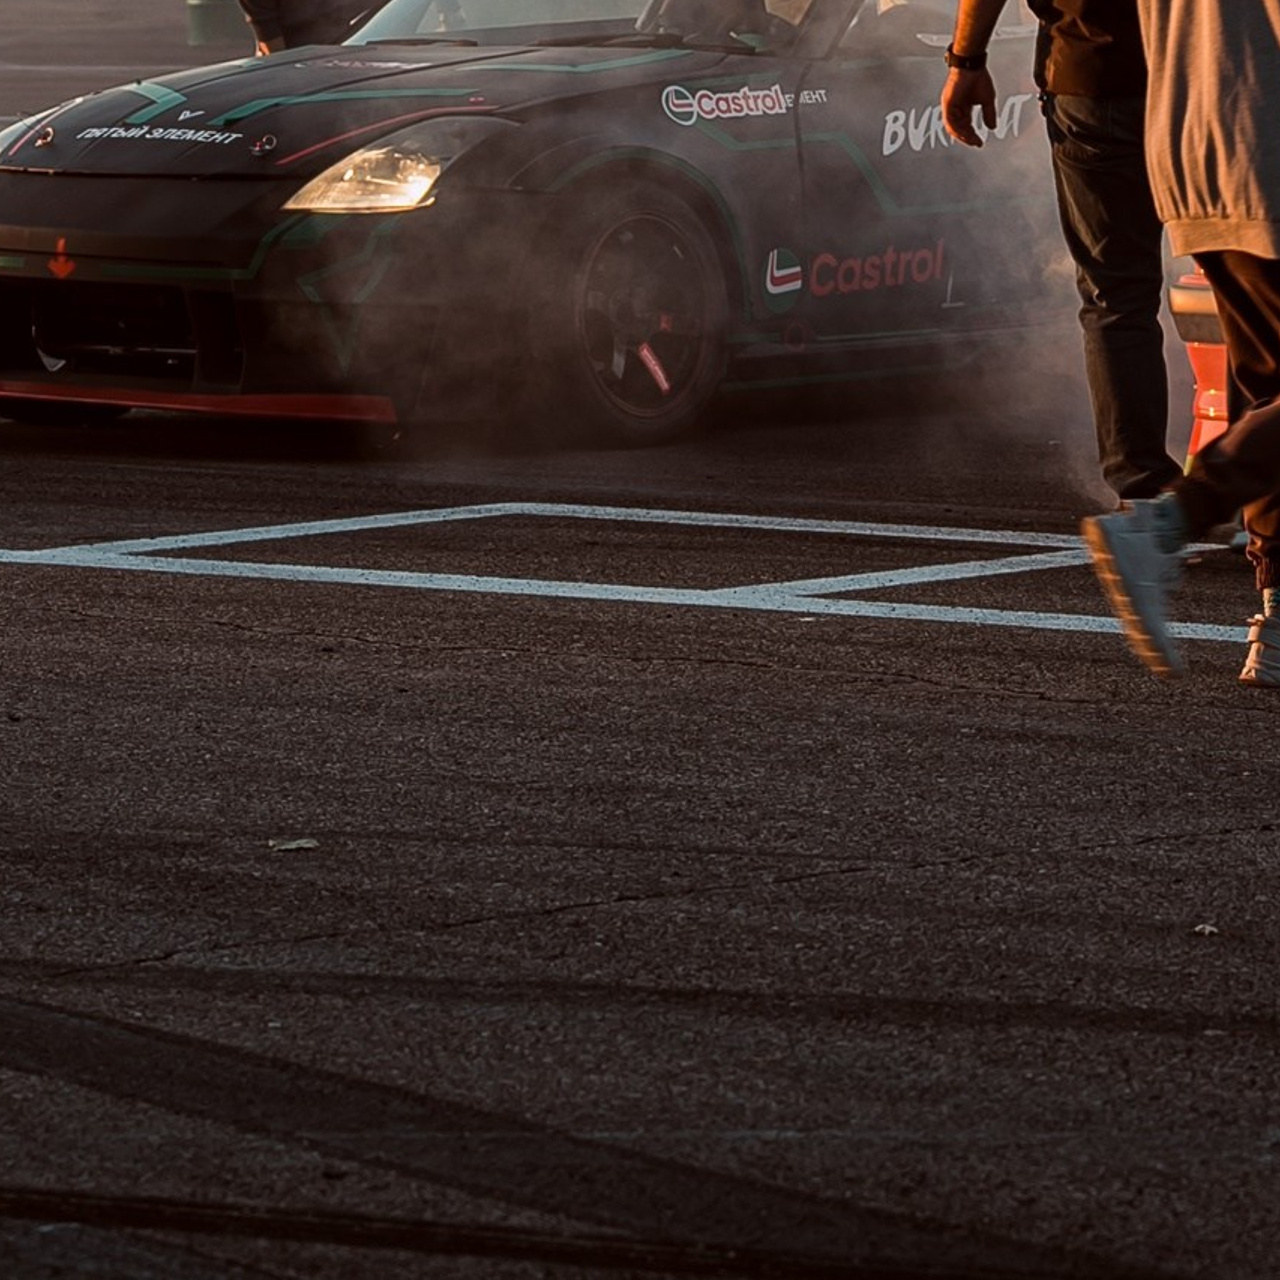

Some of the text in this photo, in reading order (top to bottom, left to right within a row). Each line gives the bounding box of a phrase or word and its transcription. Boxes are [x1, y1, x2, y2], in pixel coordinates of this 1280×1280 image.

[695, 84, 787, 119] Castrol
[882, 93, 1033, 156] BUROUT
[145, 127, 243, 144] ЭЛЕМЕНТ
[809, 237, 945, 297] Castrol
